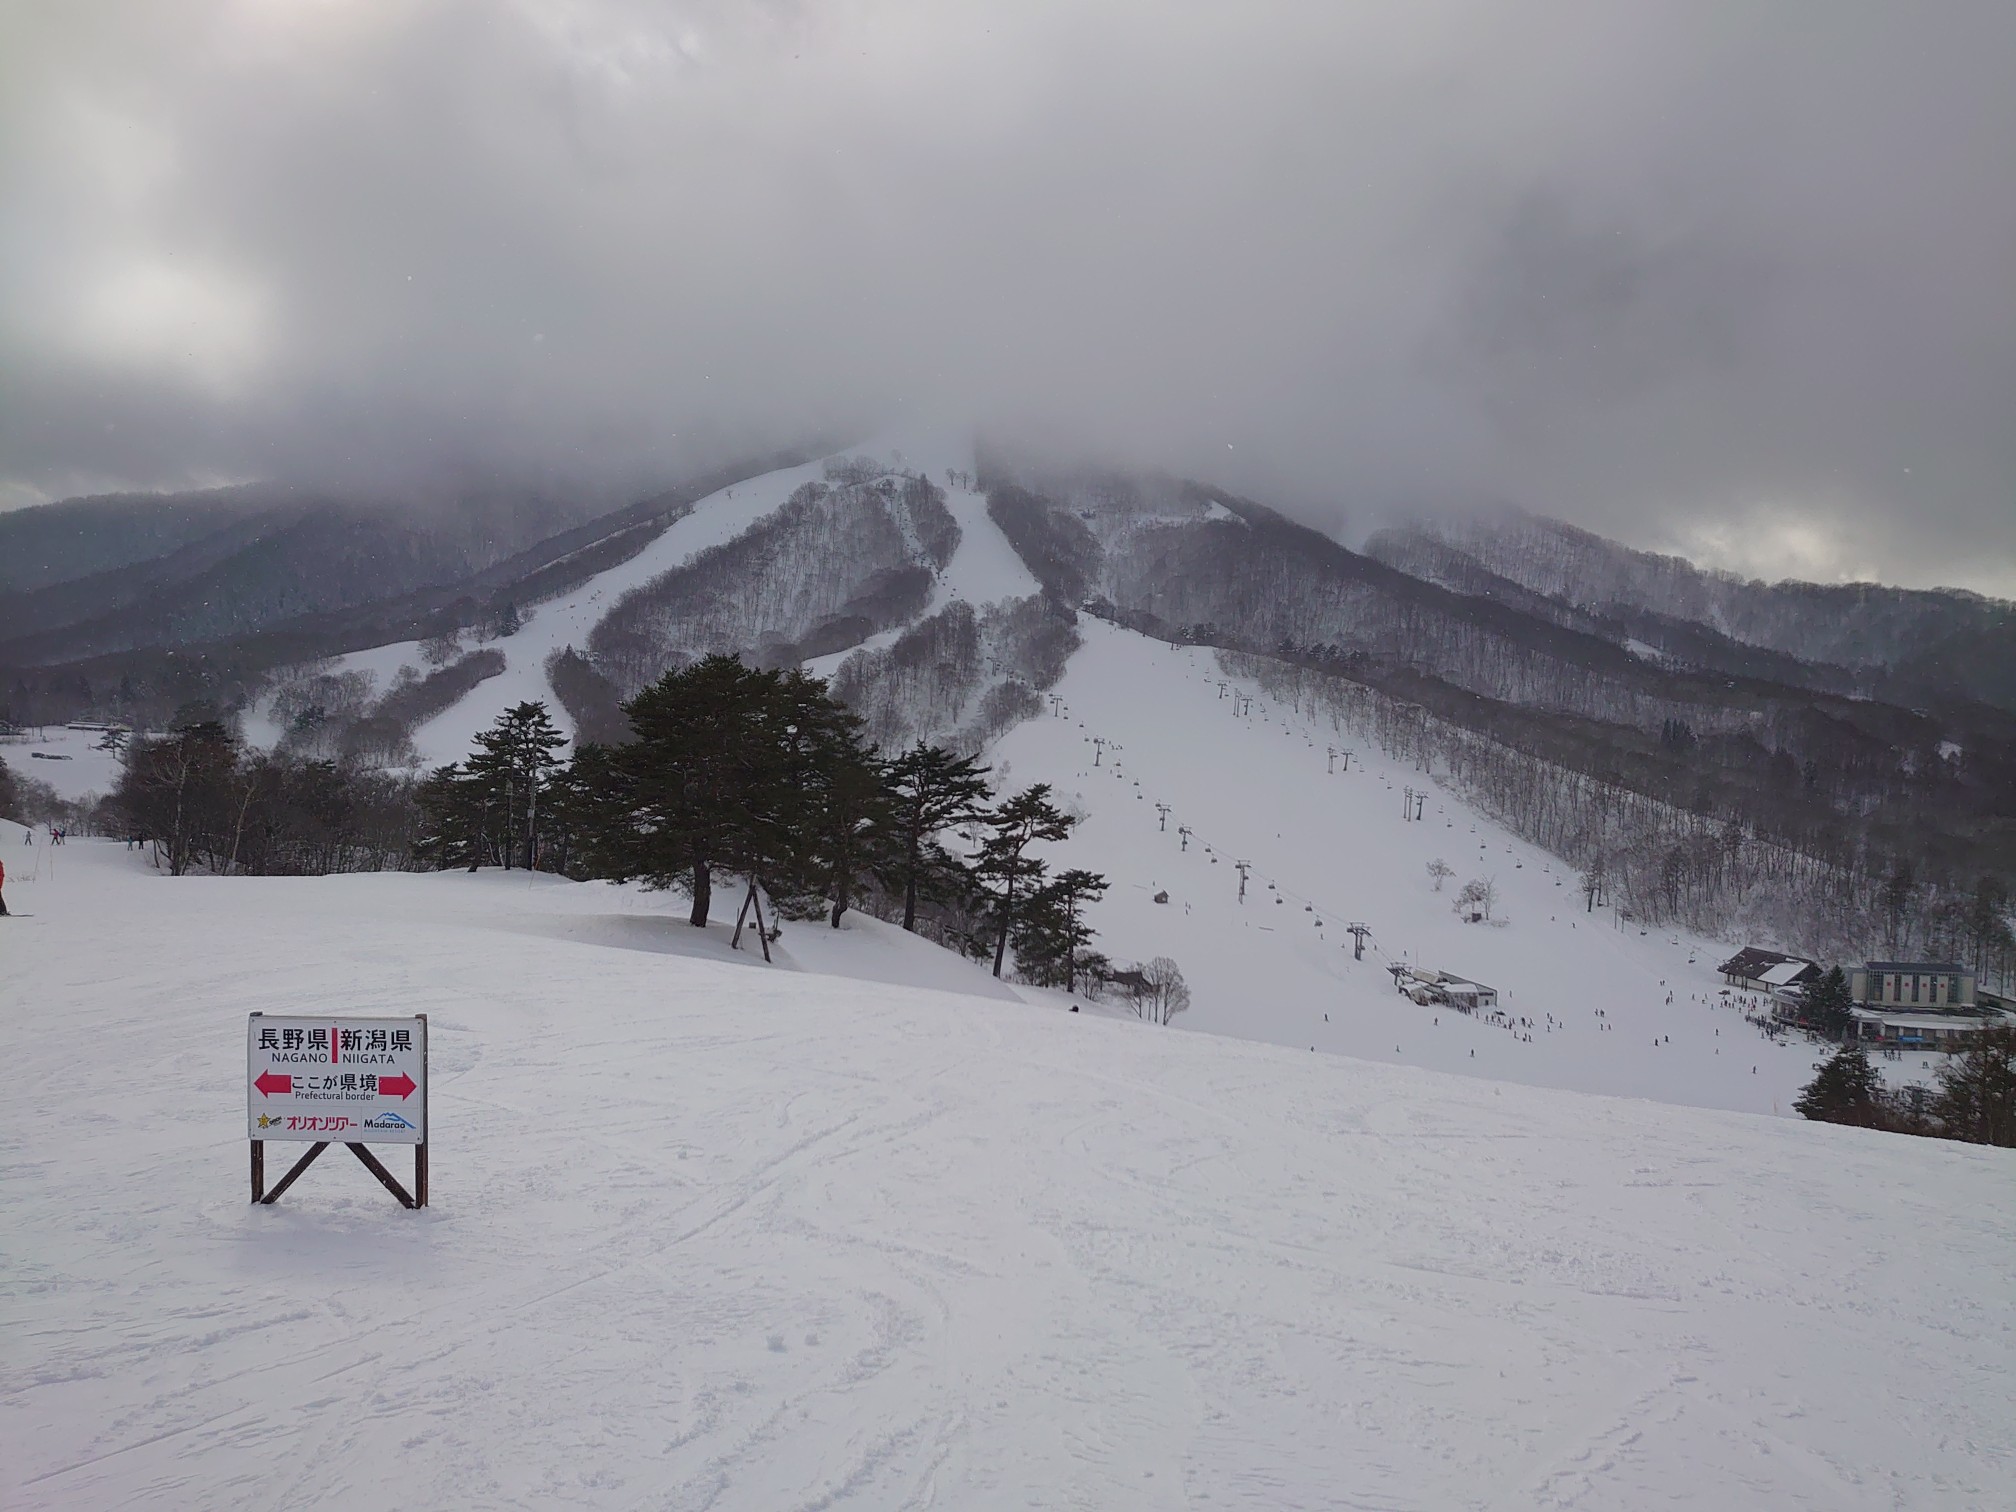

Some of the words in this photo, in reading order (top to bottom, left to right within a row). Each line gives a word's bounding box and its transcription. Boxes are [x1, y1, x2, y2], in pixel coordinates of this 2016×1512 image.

[258, 1029, 329, 1051] 長野県
[340, 1029, 412, 1052] 新潟県
[272, 1053, 327, 1063] NAGANO
[343, 1054, 395, 1064] NIIGATA
[292, 1074, 377, 1091] ここが県境
[295, 1091, 343, 1101] Prefectural
[345, 1092, 374, 1101] border
[364, 1118, 405, 1129] Madarao
